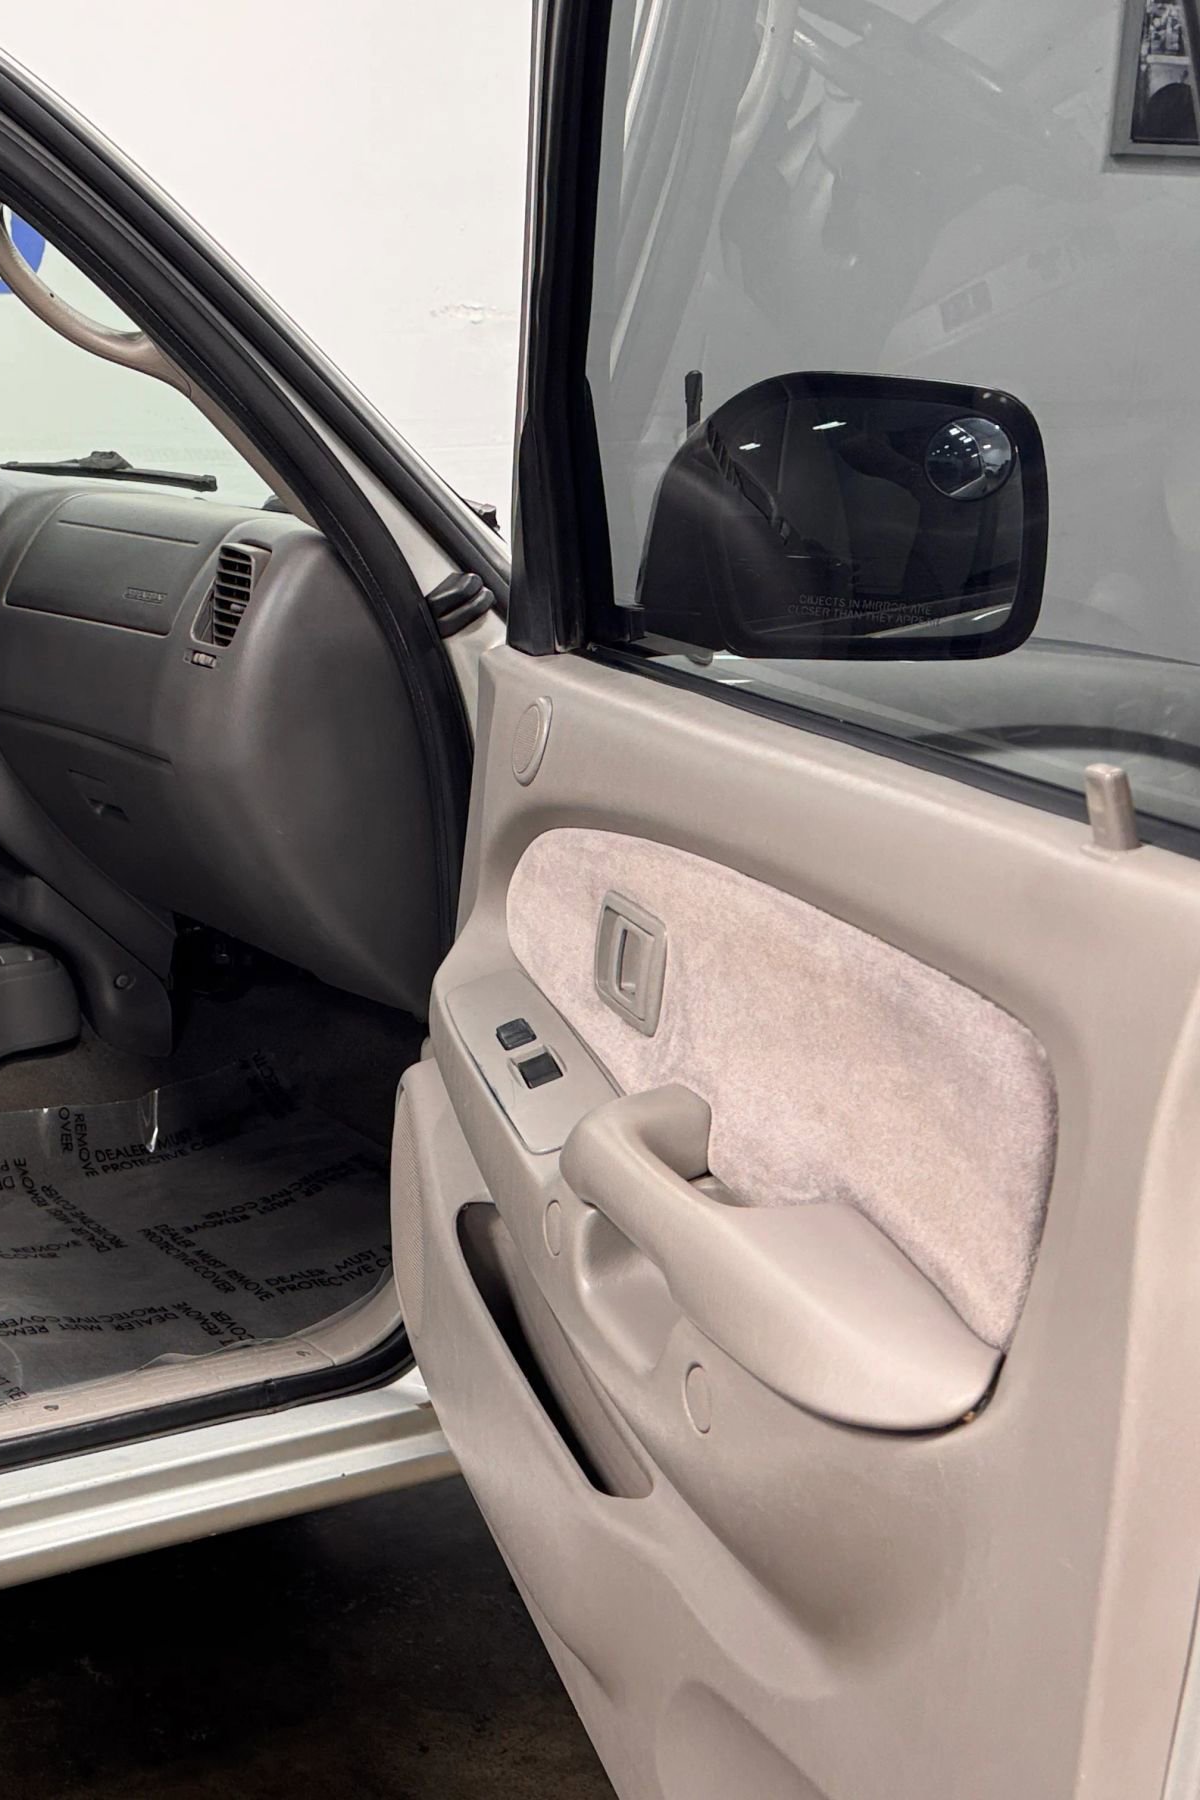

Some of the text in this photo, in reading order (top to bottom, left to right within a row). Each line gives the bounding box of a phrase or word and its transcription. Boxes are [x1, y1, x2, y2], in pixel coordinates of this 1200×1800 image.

[833, 607, 862, 619] THAN
[848, 598, 861, 608] IN
[73, 1113, 100, 1178] REMOVE
[94, 1143, 150, 1163] DEALER
[157, 1127, 193, 1151] MUST
[102, 1148, 190, 1175] PROTECTIVE
[14, 1157, 51, 1209] REMOVE
[200, 1201, 259, 1221] COVER
[255, 1196, 299, 1216] MUST
[180, 1213, 253, 1235] REMOVE
[0, 1252, 61, 1261] COVER
[10, 1239, 83, 1254] REMOVE
[135, 1226, 237, 1295] PROTECTIVE COVER
[152, 1222, 277, 1303] DEALER MUST REMOVE
[264, 1267, 329, 1287] DEALER
[334, 1248, 378, 1273] MUST
[275, 1262, 376, 1296] PROTECTIVE
[61, 1304, 170, 1324] PROTECTIVE
[111, 1311, 181, 1333] DEALER
[170, 1300, 225, 1337] REMOVE
[57, 1322, 105, 1333] MUST
